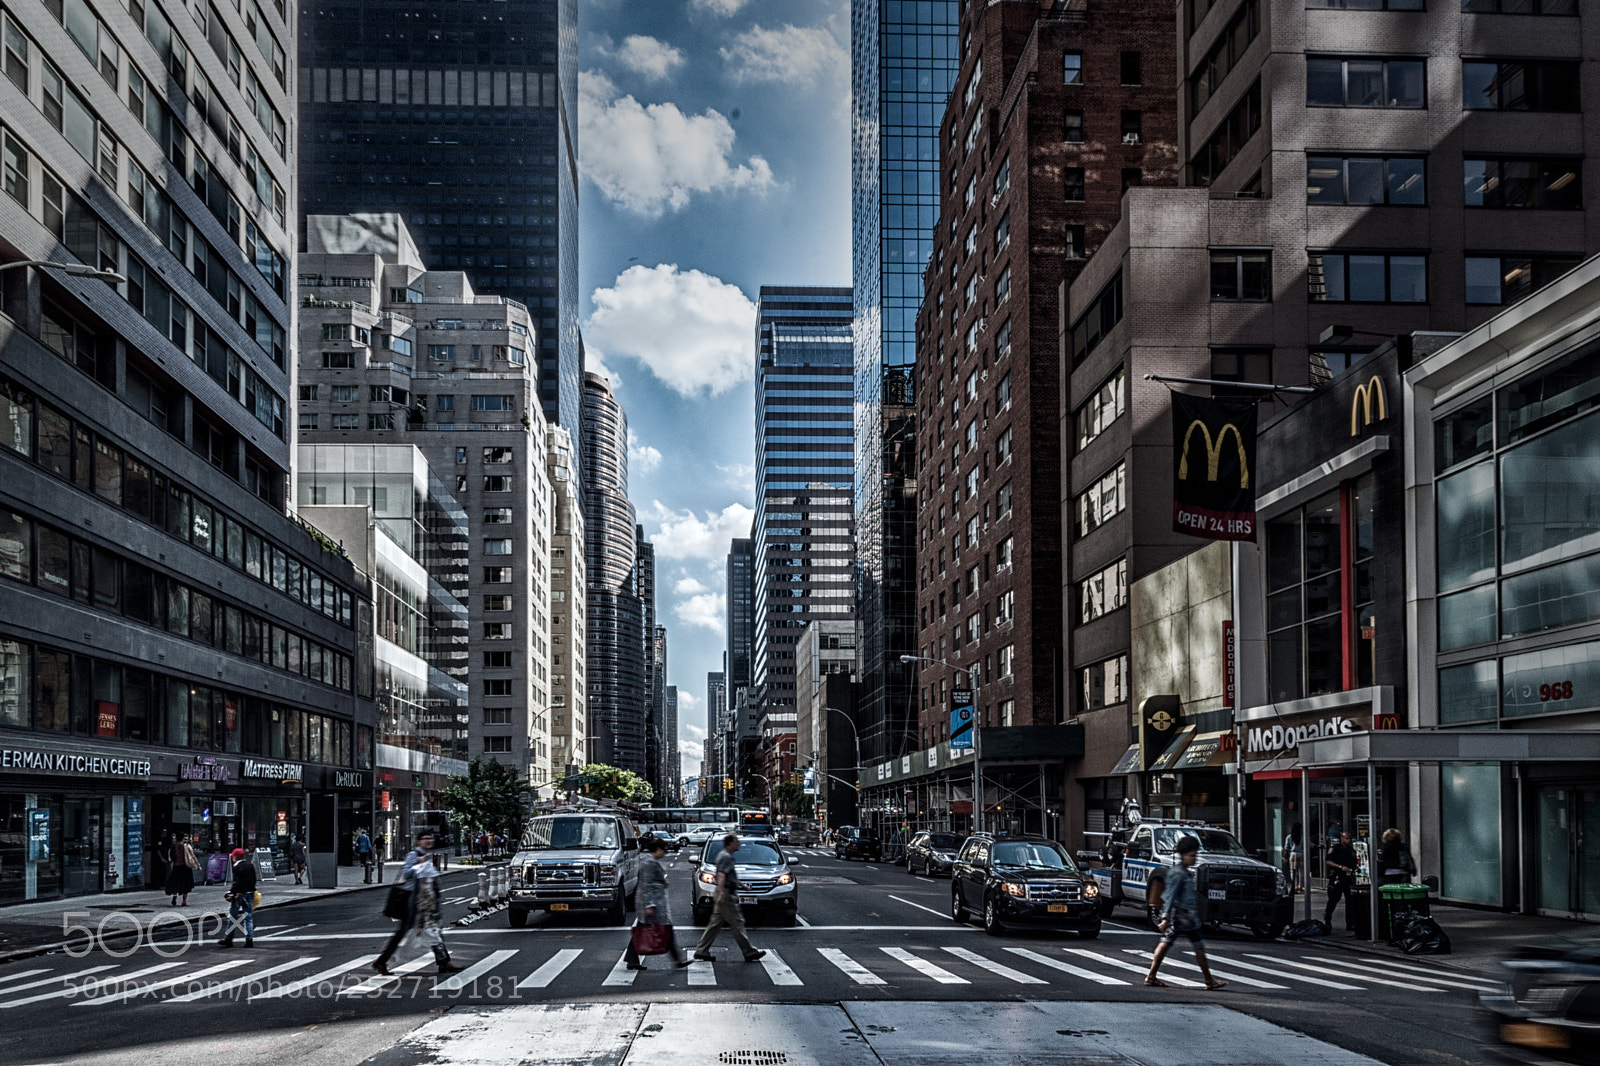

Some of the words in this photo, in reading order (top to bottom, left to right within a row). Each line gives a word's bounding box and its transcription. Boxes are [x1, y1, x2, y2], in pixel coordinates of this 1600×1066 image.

[1177, 510, 1207, 530] OPEN
[1209, 517, 1224, 532] 24
[1227, 519, 1252, 534] HRS
[1540, 680, 1573, 702] 968
[99, 712, 117, 722] JENSEN
[99, 720, 115, 730] LEWIS
[1247, 716, 1354, 753] McDonald's
[0, 750, 53, 770] ERMAN
[56, 753, 109, 774] KITCHEN
[110, 758, 151, 776] CENTER
[1126, 866, 1144, 882] NYPD
